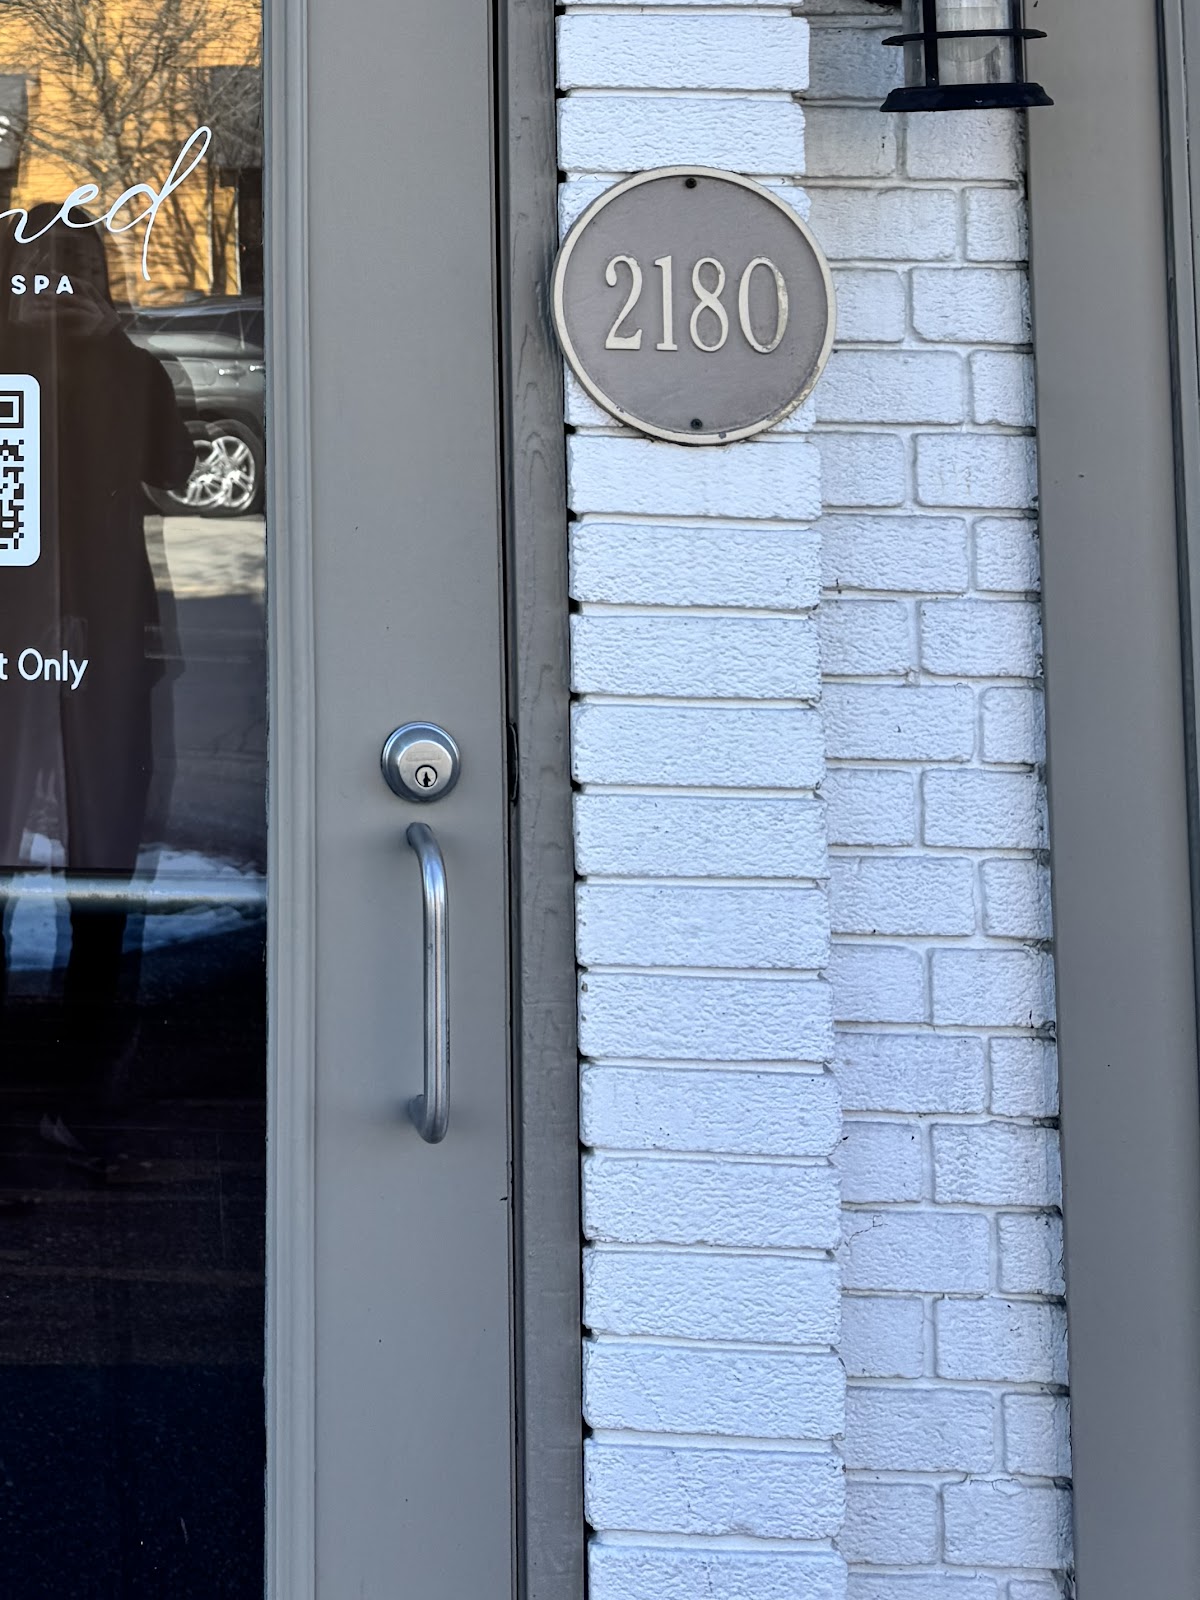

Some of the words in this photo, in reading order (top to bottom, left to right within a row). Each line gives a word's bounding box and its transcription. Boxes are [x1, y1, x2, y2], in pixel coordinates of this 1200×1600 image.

[11, 274, 74, 295] SPA
[604, 254, 789, 354] 2180
[18, 648, 89, 690] Only
